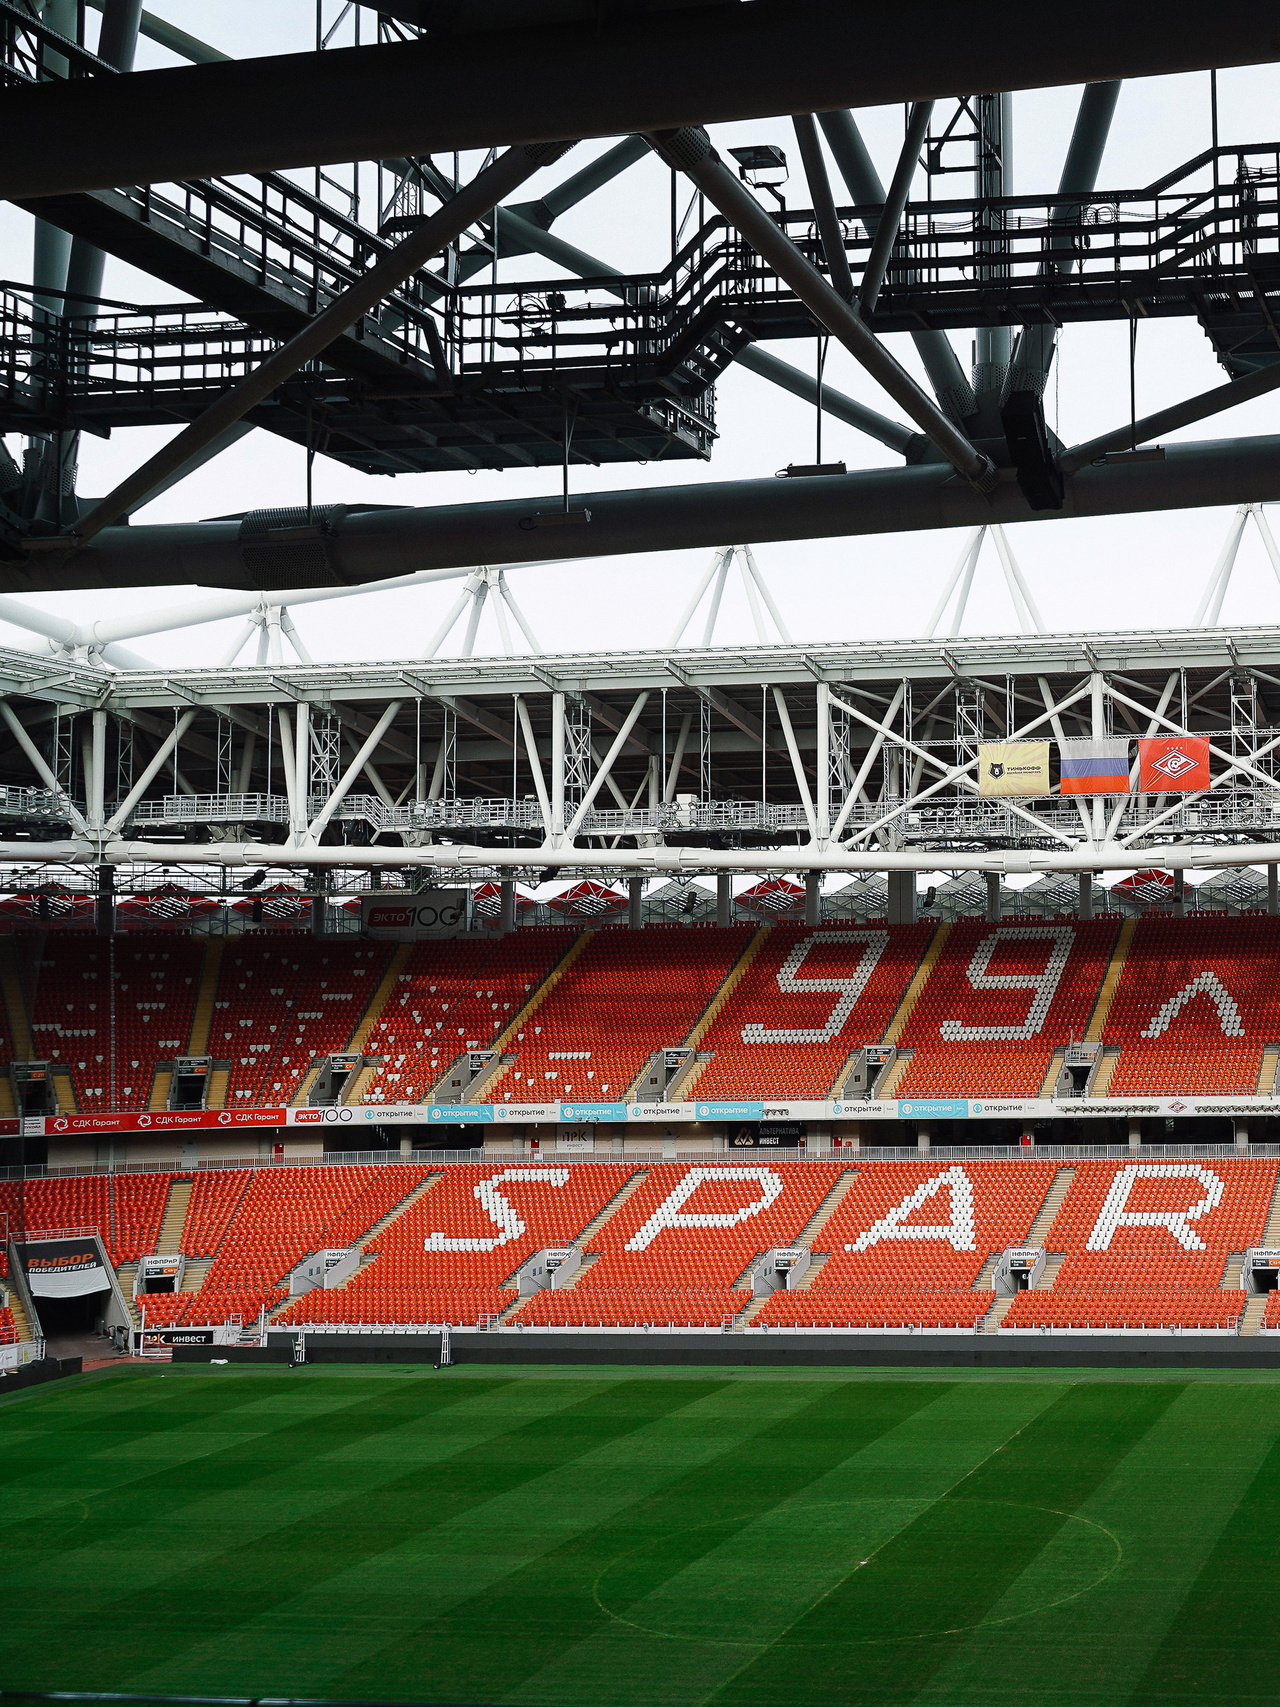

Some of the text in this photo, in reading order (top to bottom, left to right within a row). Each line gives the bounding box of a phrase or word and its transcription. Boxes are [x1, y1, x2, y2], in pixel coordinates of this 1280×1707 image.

[740, 925, 1076, 1044] 99
[643, 1107, 680, 1115] открытие
[844, 1105, 882, 1113] открытие
[984, 1104, 1023, 1112] открытие
[235, 1113, 280, 1121] СДК Гарант
[377, 1111, 413, 1119] открытие
[509, 1109, 545, 1117] открытие
[72, 1119, 120, 1128] СДК Гарант
[155, 1116, 202, 1124] СДК Гарант
[27, 1253, 94, 1268] ВЫБОР
[28, 1261, 97, 1273] ПОБЕДИТЕЛЕЙ
